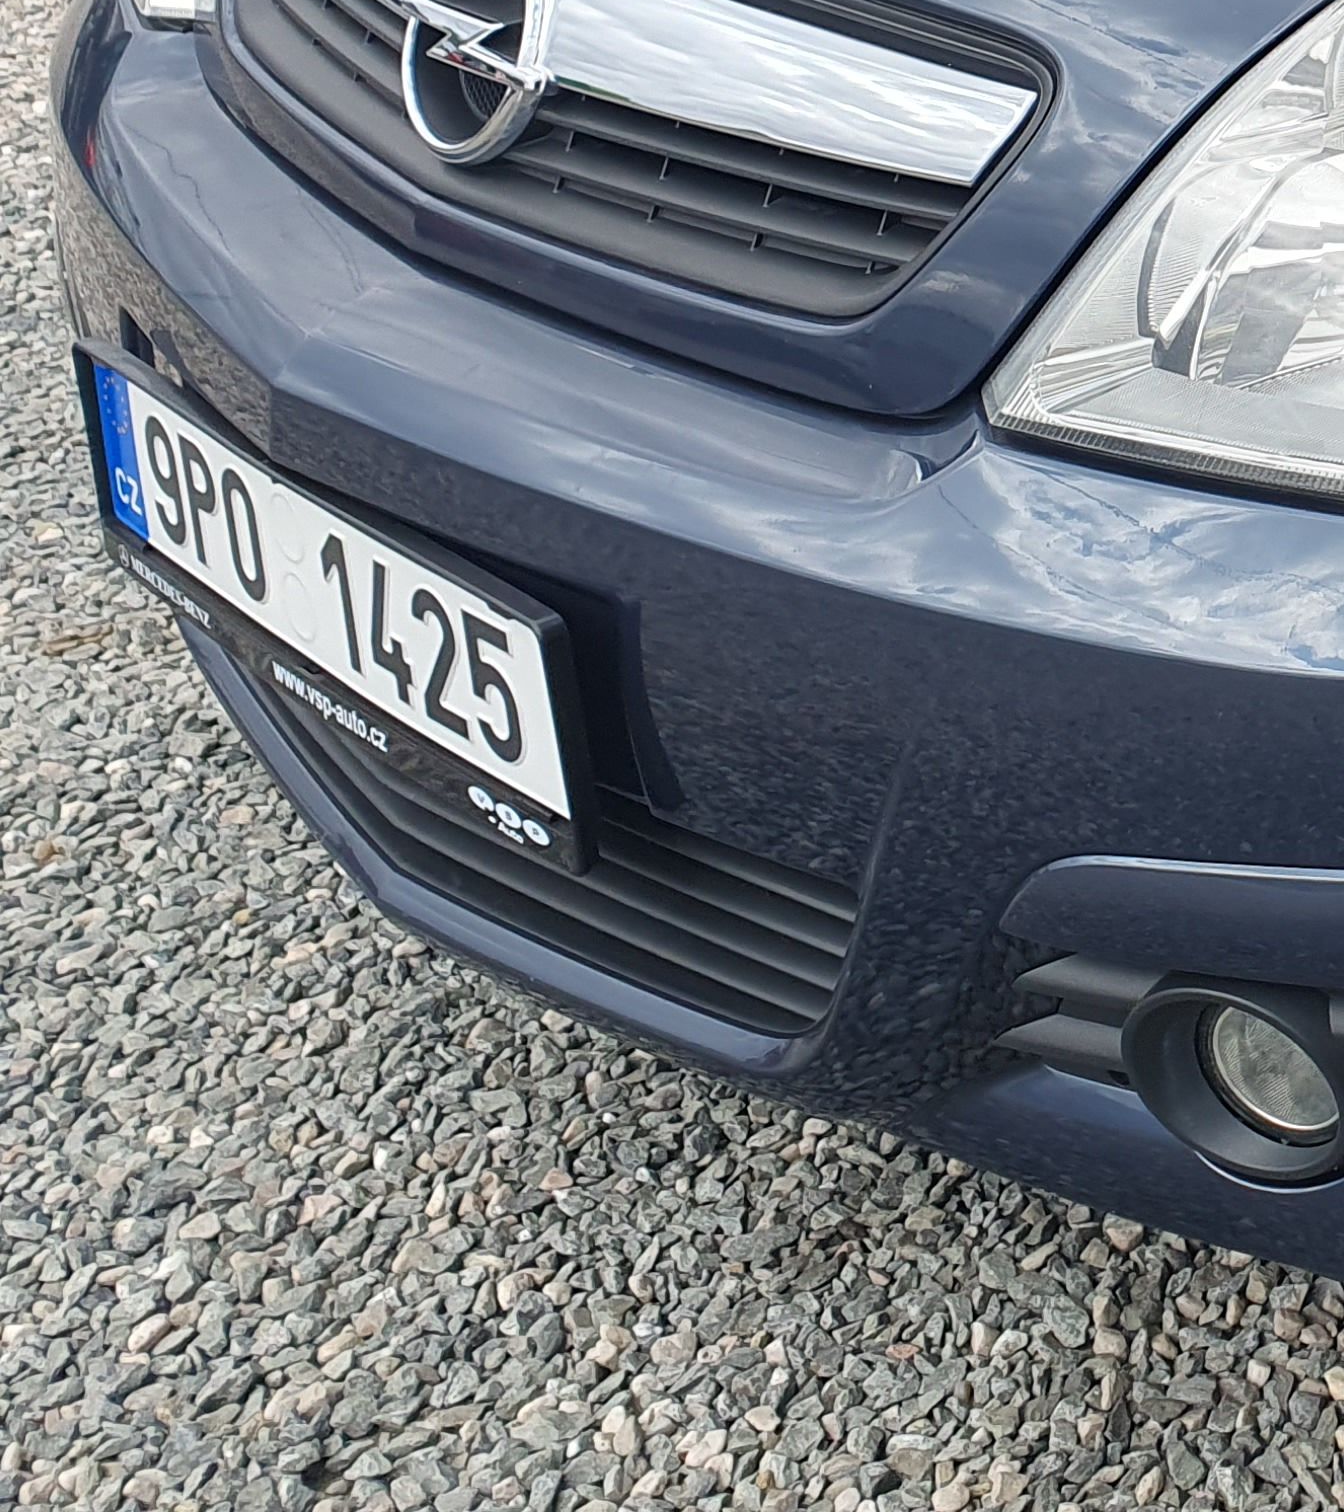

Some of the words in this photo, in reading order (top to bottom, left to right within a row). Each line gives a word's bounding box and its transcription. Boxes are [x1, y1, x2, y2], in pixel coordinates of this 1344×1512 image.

[115, 467, 143, 516] CZ
[145, 415, 266, 602] 9P0
[320, 533, 523, 763] 1425
[271, 660, 388, 753] www.vsp-auto.cz
